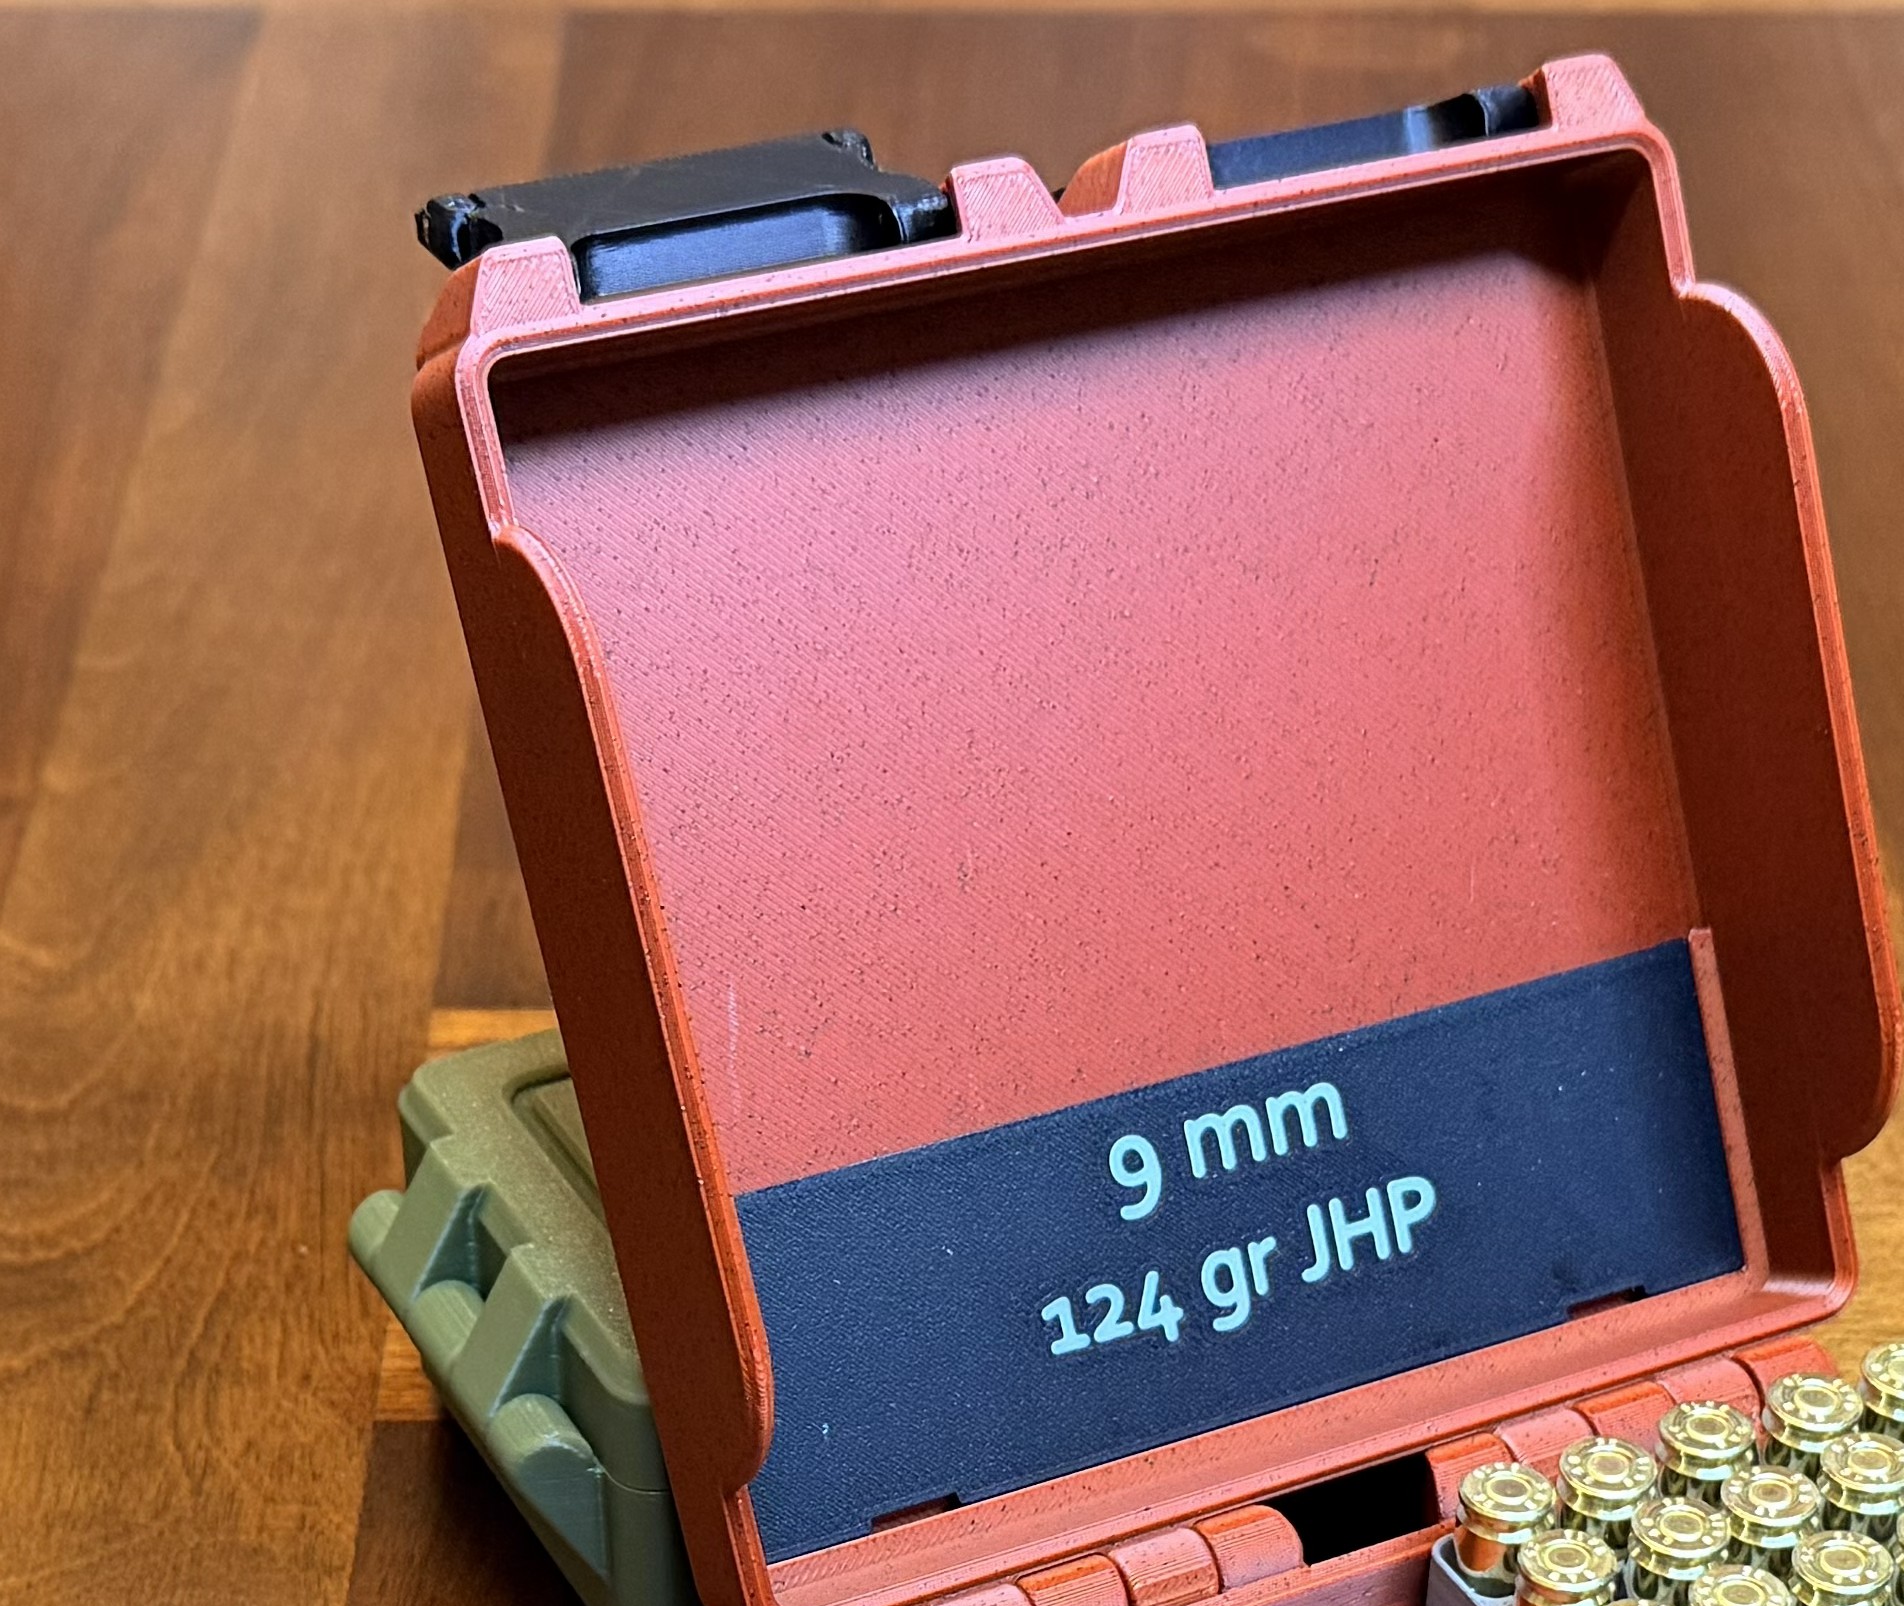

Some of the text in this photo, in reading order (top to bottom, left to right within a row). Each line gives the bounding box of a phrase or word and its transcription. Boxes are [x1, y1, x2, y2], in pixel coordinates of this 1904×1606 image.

[1108, 1081, 1348, 1221] 9 mm
[1041, 1175, 1437, 1356] 124 gr JHP
